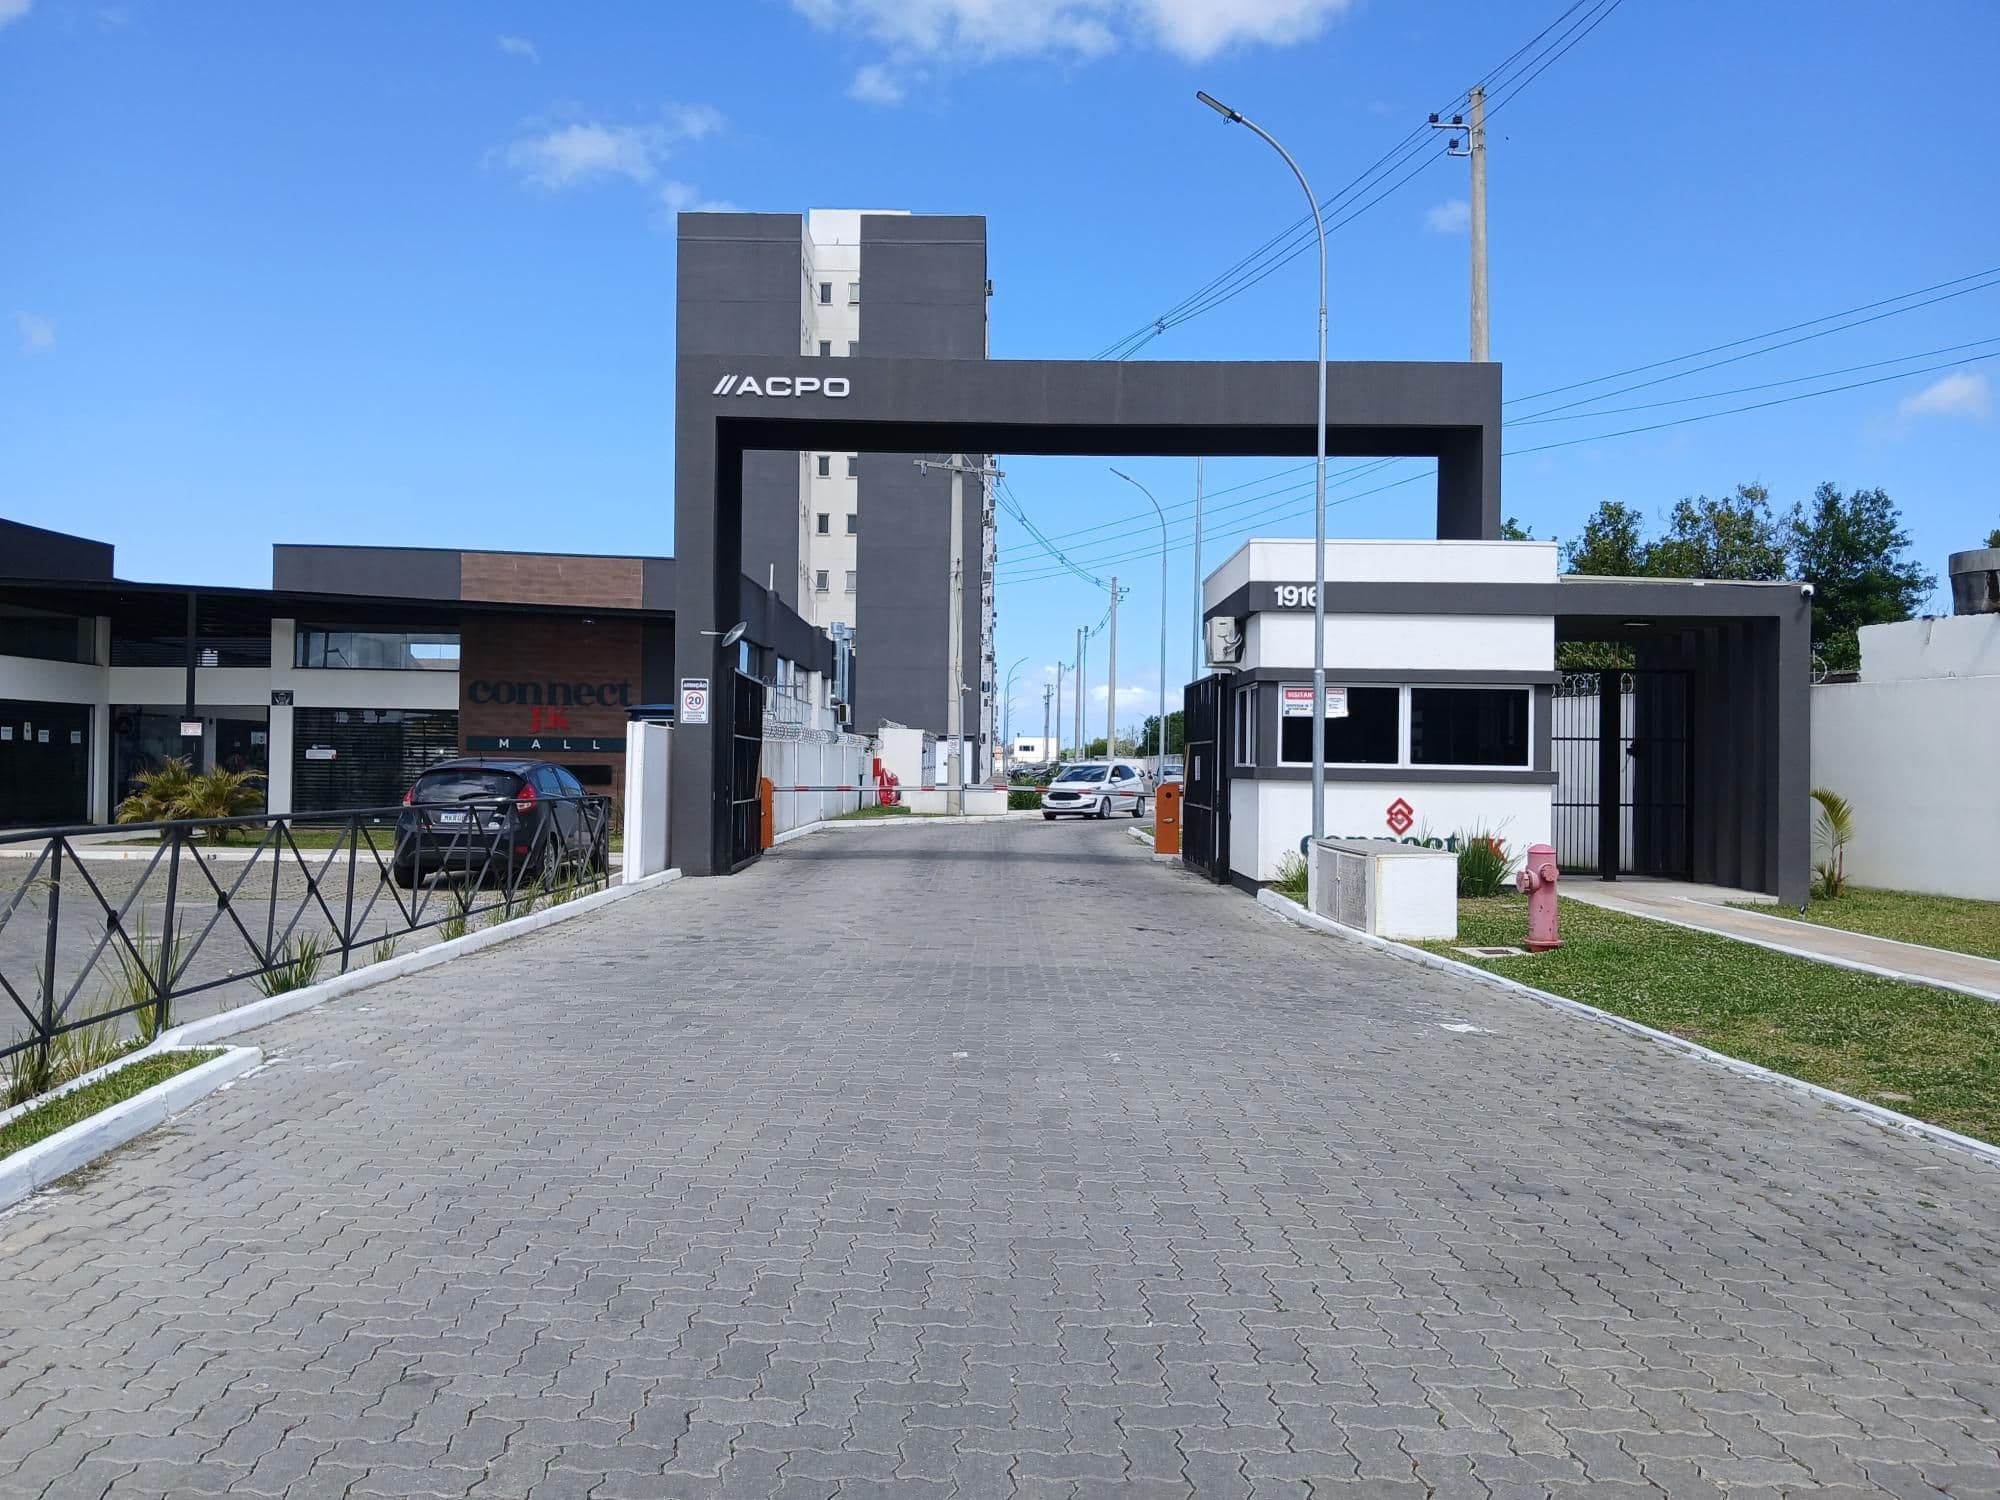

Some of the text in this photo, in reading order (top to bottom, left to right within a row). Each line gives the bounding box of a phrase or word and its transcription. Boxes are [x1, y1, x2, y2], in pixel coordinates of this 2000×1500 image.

[1274, 585, 1317, 607] 1916
[468, 678, 632, 706] connect
[688, 696, 701, 705] 20
[529, 705, 571, 734] JK
[499, 738, 600, 750] MALL
